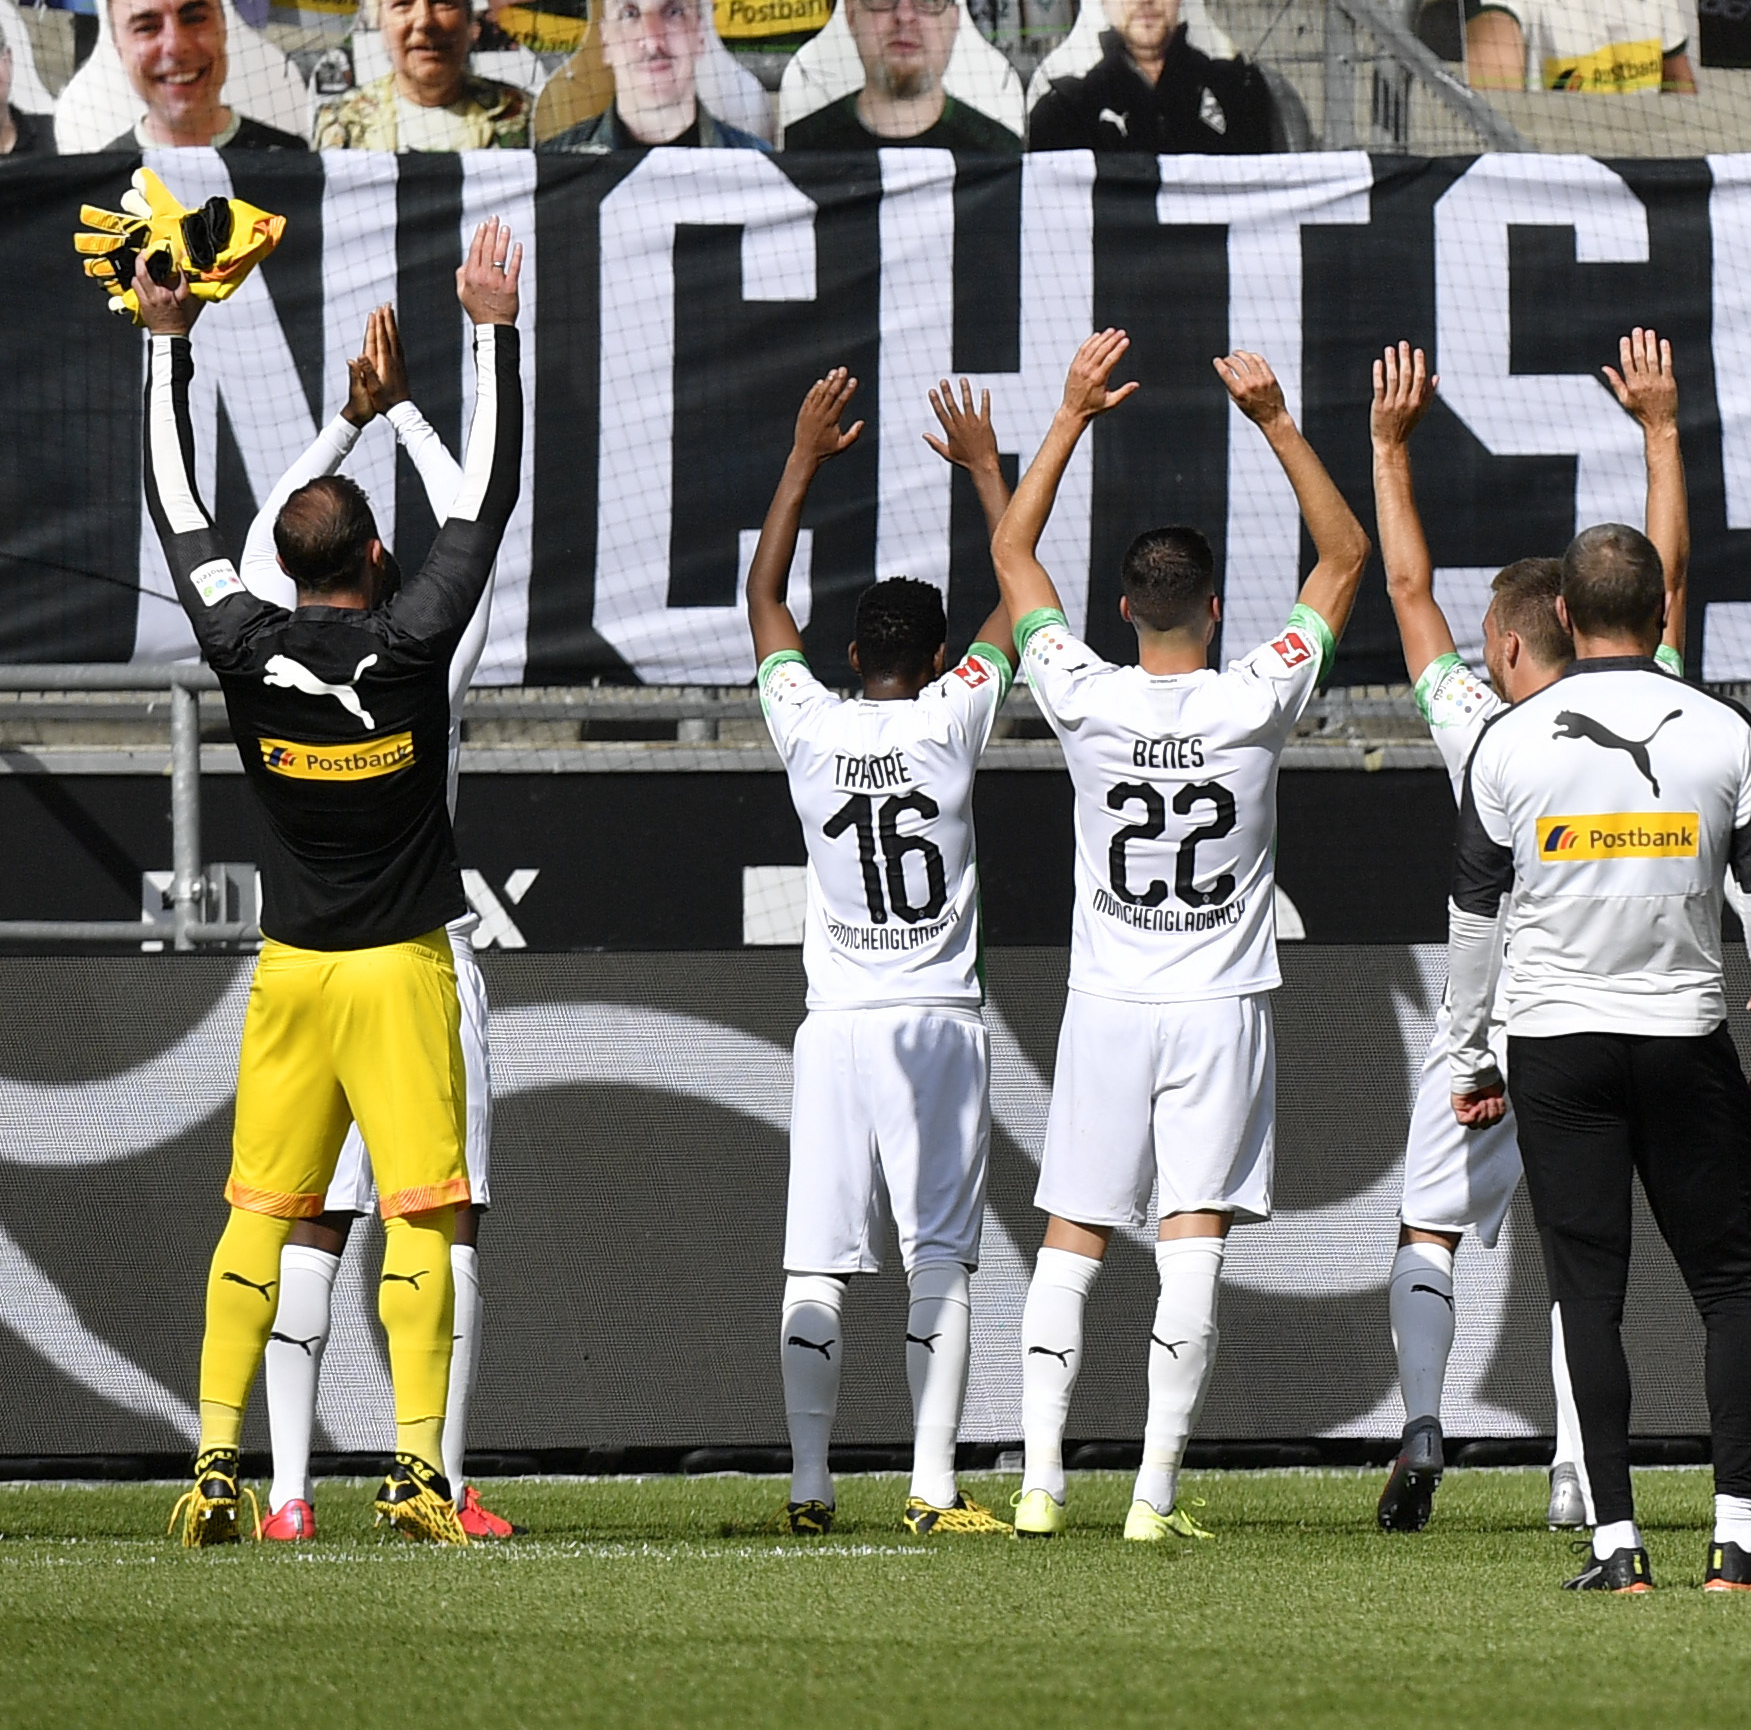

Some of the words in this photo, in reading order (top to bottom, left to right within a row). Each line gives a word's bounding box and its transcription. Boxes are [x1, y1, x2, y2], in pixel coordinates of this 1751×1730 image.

[306, 742, 414, 773] Postbank
[1133, 738, 1204, 770] BENES
[1106, 781, 1237, 909] 22
[1589, 826, 1694, 851] Postbank
[822, 790, 948, 925] 16
